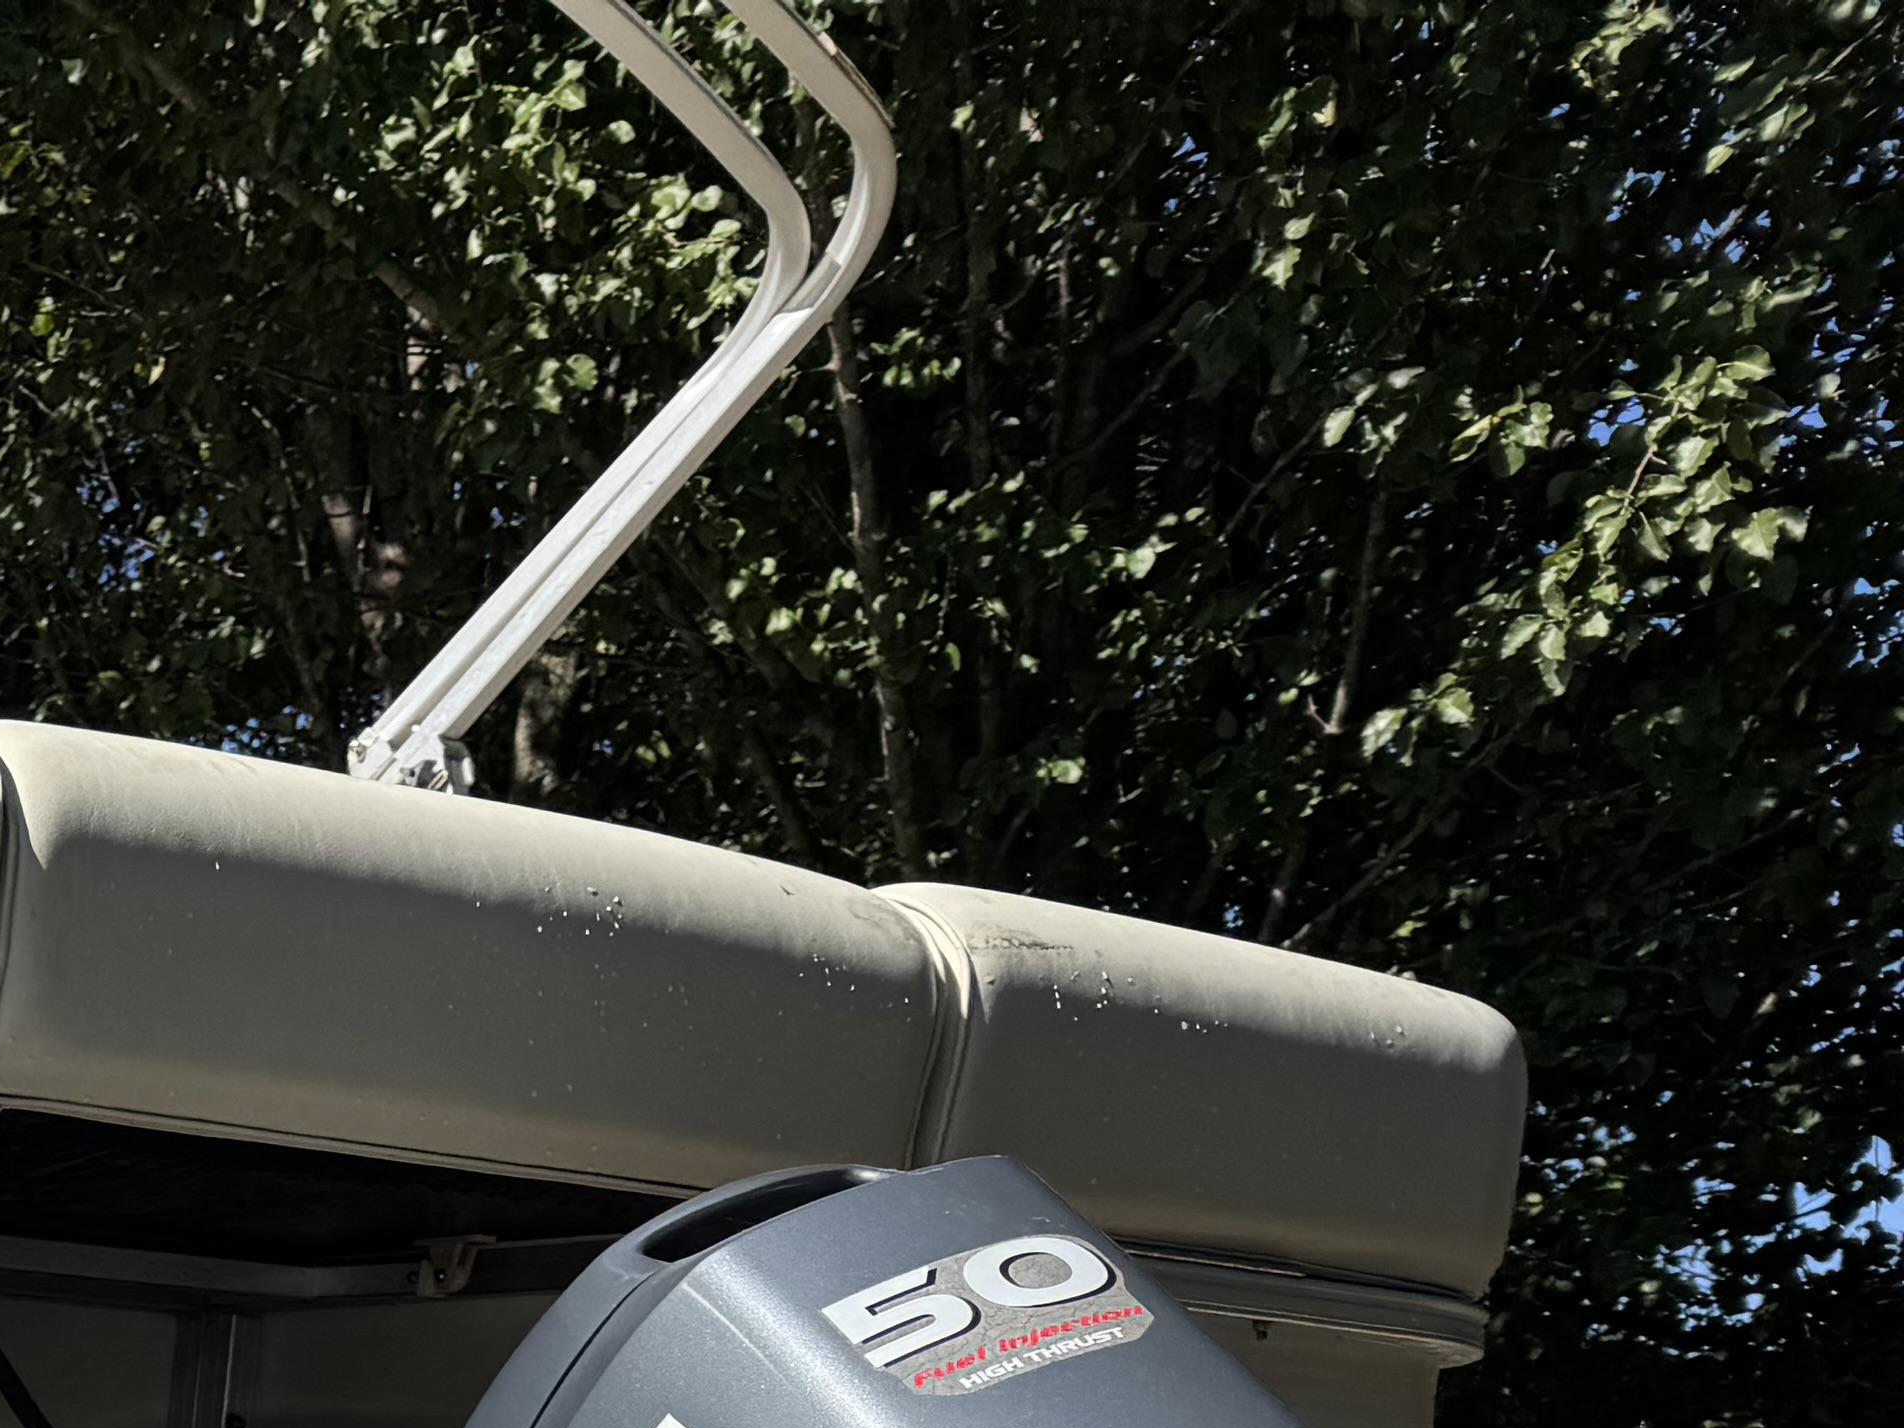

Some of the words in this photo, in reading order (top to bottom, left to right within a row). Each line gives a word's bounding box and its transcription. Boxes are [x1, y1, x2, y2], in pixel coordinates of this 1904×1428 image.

[820, 1236, 1118, 1369] 50
[958, 1356, 1025, 1389] HIGH
[1022, 1326, 1126, 1364] THRUST
